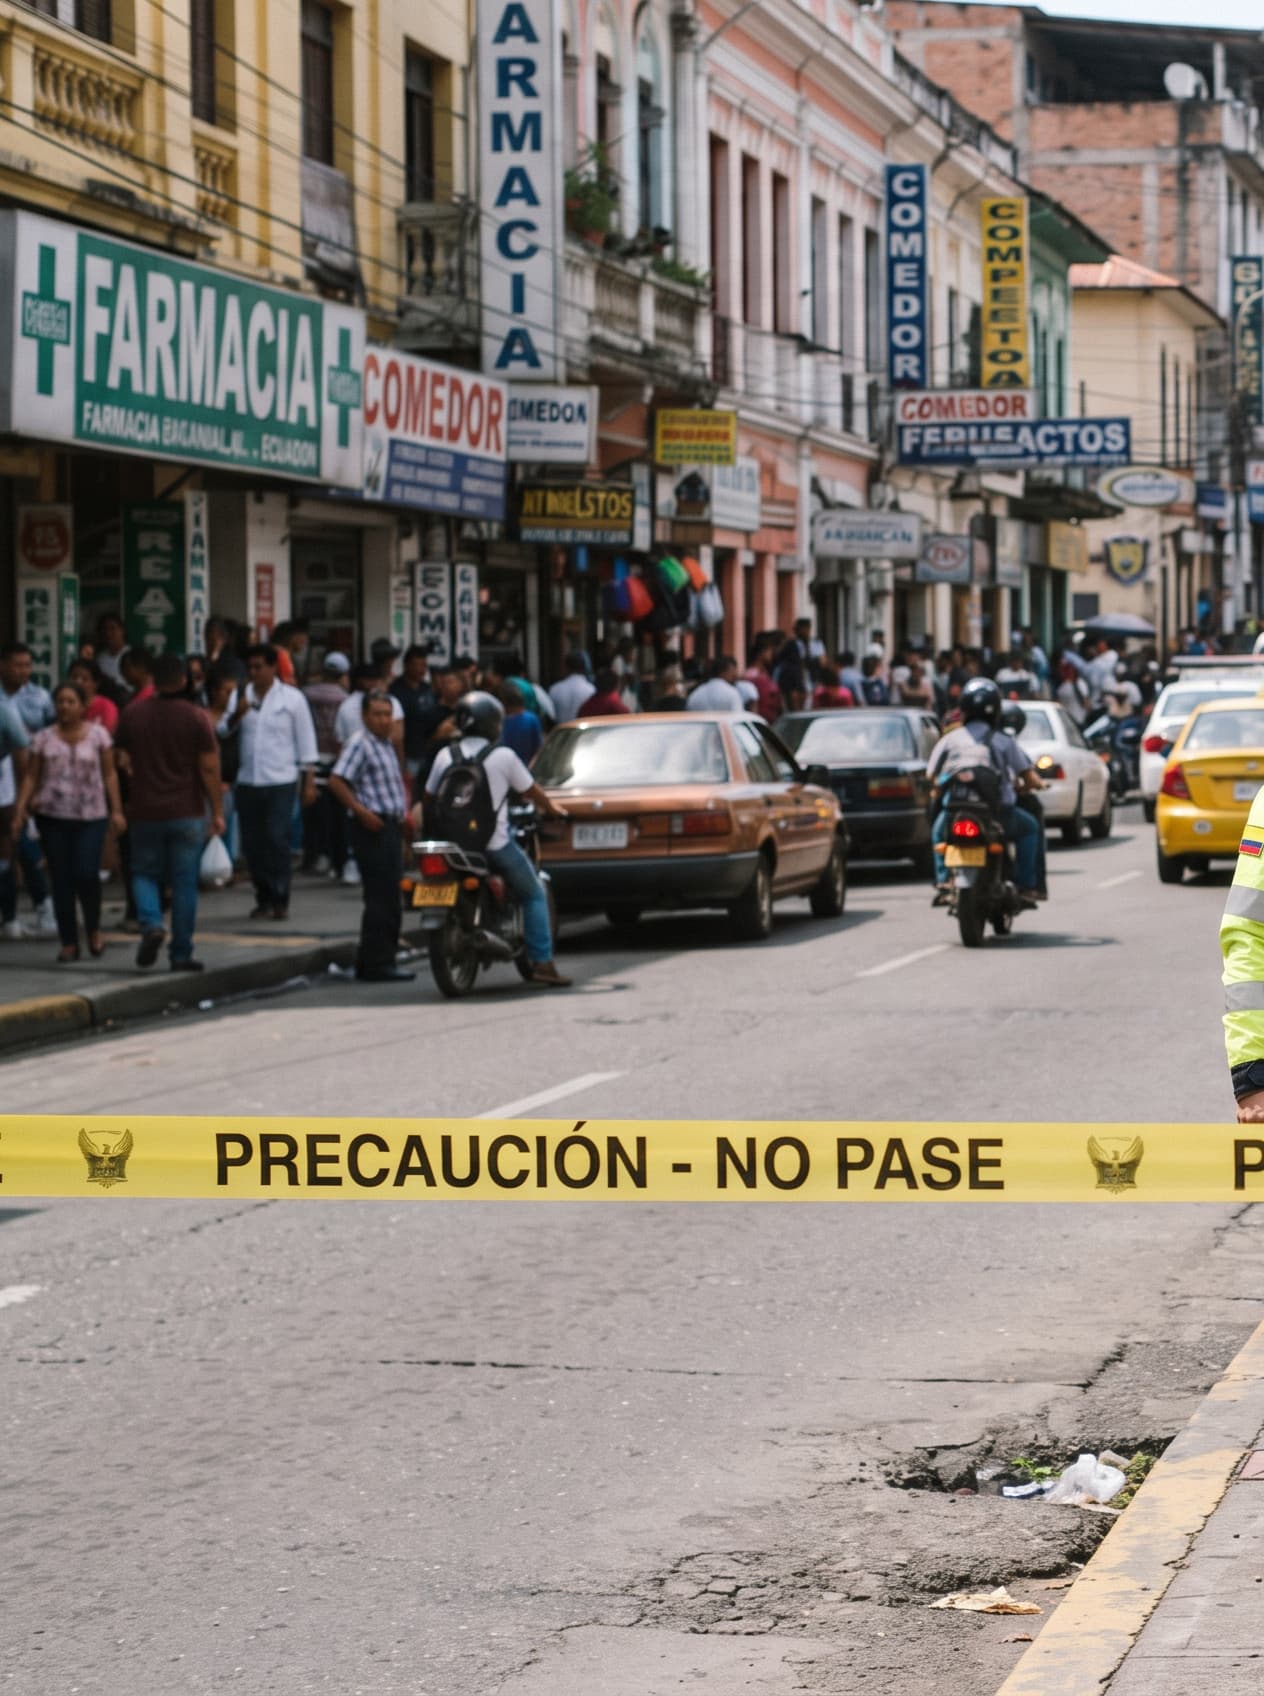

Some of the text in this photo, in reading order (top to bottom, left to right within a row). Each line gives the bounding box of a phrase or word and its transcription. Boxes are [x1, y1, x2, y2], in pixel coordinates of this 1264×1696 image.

[890, 171, 923, 380] COMEDOR
[83, 253, 317, 428] FARMACIA
[82, 401, 160, 446] FARMACIA
[363, 353, 503, 453] COMEDOR
[901, 395, 1028, 419] COMEDOR
[215, 1121, 1005, 1191] PRECAUCIÓN - NO PASE
